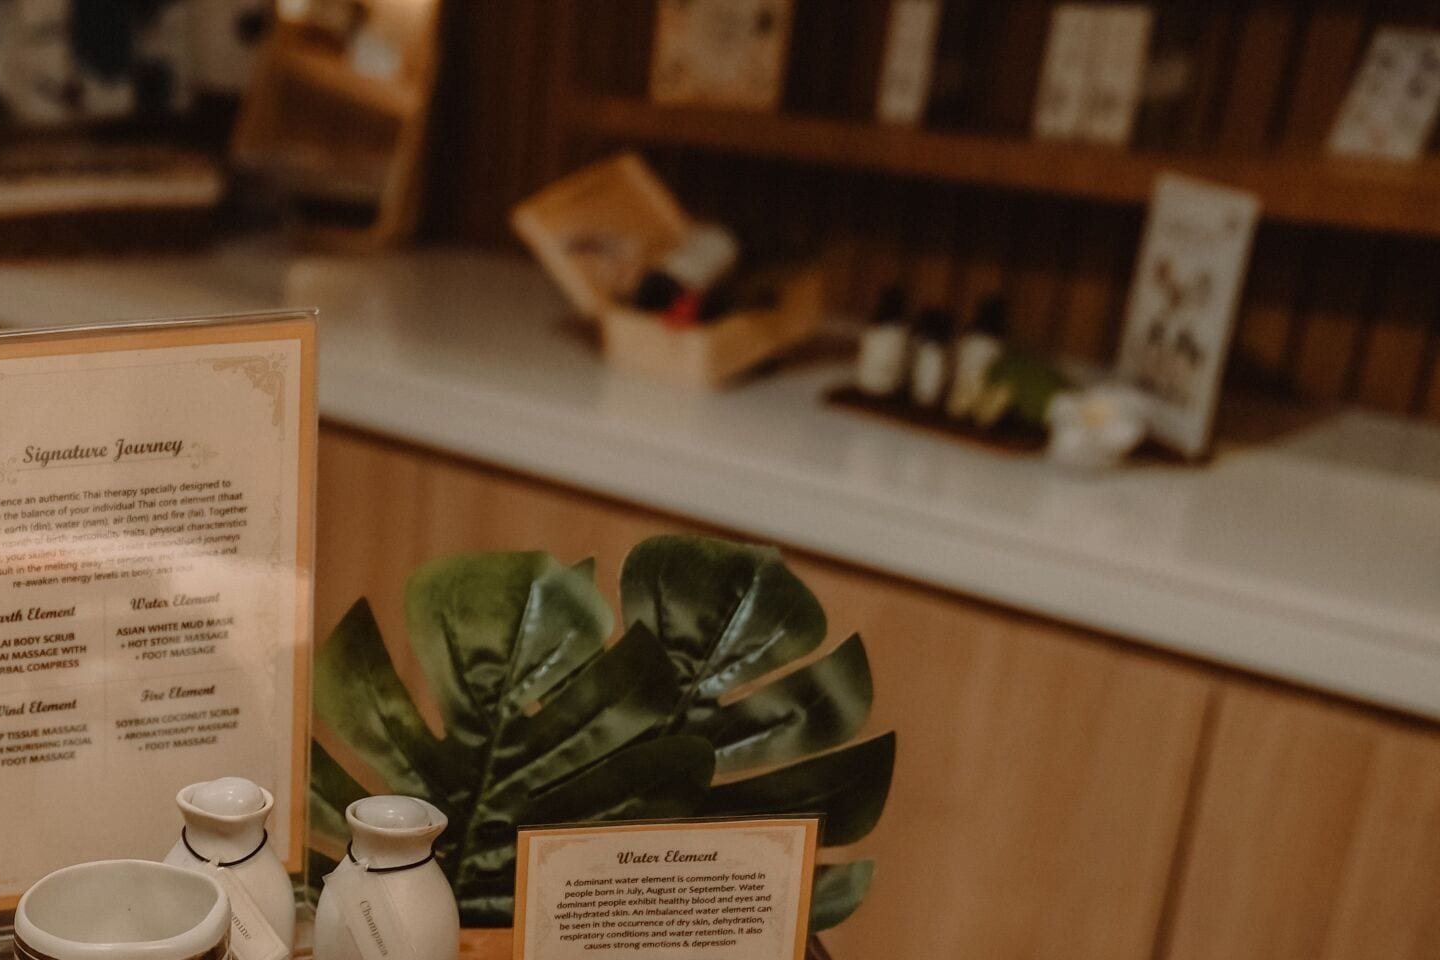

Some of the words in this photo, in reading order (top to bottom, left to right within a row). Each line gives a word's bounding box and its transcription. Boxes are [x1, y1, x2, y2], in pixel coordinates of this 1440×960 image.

[22, 444, 109, 465] Signature
[115, 437, 184, 458] Journey
[38, 491, 81, 504] authentic
[83, 490, 102, 500] Thai
[103, 488, 138, 498] therapy
[140, 483, 178, 497] specially
[179, 480, 220, 492] designed
[130, 598, 170, 610] Water
[172, 592, 221, 607] Element
[27, 605, 76, 621] Element
[115, 626, 146, 637] ASIAN
[147, 622, 178, 633] WHITE
[181, 620, 204, 630] MUD
[206, 616, 235, 628] MASK
[13, 636, 41, 647] BODY
[43, 632, 76, 644] SCRUB
[128, 638, 148, 648] HOT
[150, 635, 181, 647] STONE
[184, 630, 229, 642] MASSAGE
[11, 647, 58, 660] MASSAGE
[60, 644, 88, 655] WITH
[142, 650, 168, 660] FOOT
[169, 645, 216, 657] MASSAGE
[26, 659, 80, 672] COMPRESS
[140, 689, 165, 703] Fire
[168, 684, 216, 699] Element
[29, 698, 77, 714] Element
[115, 717, 160, 729] SOYBEAN
[161, 711, 207, 724] COCONUT
[209, 707, 240, 719] SCRUB
[6, 729, 39, 740] TISSUE
[42, 723, 88, 736] MASSAGE
[124, 726, 196, 740] AROMATHERAPY
[197, 720, 239, 732] MASSAGE
[5, 740, 61, 753] NOURISHING
[62, 737, 93, 747] FACIAL
[145, 740, 171, 751] FOOT
[173, 735, 218, 748] MASSAGE
[0, 756, 27, 767] FOOT
[29, 750, 76, 763] MASSAGE
[616, 851, 660, 864] Water
[664, 850, 718, 863] Element
[573, 878, 613, 887] dominant
[641, 876, 676, 884] element
[685, 874, 730, 883] commonly
[731, 872, 757, 881] found
[564, 889, 594, 900] people
[645, 886, 676, 896] August
[360, 900, 388, 957] Champaca
